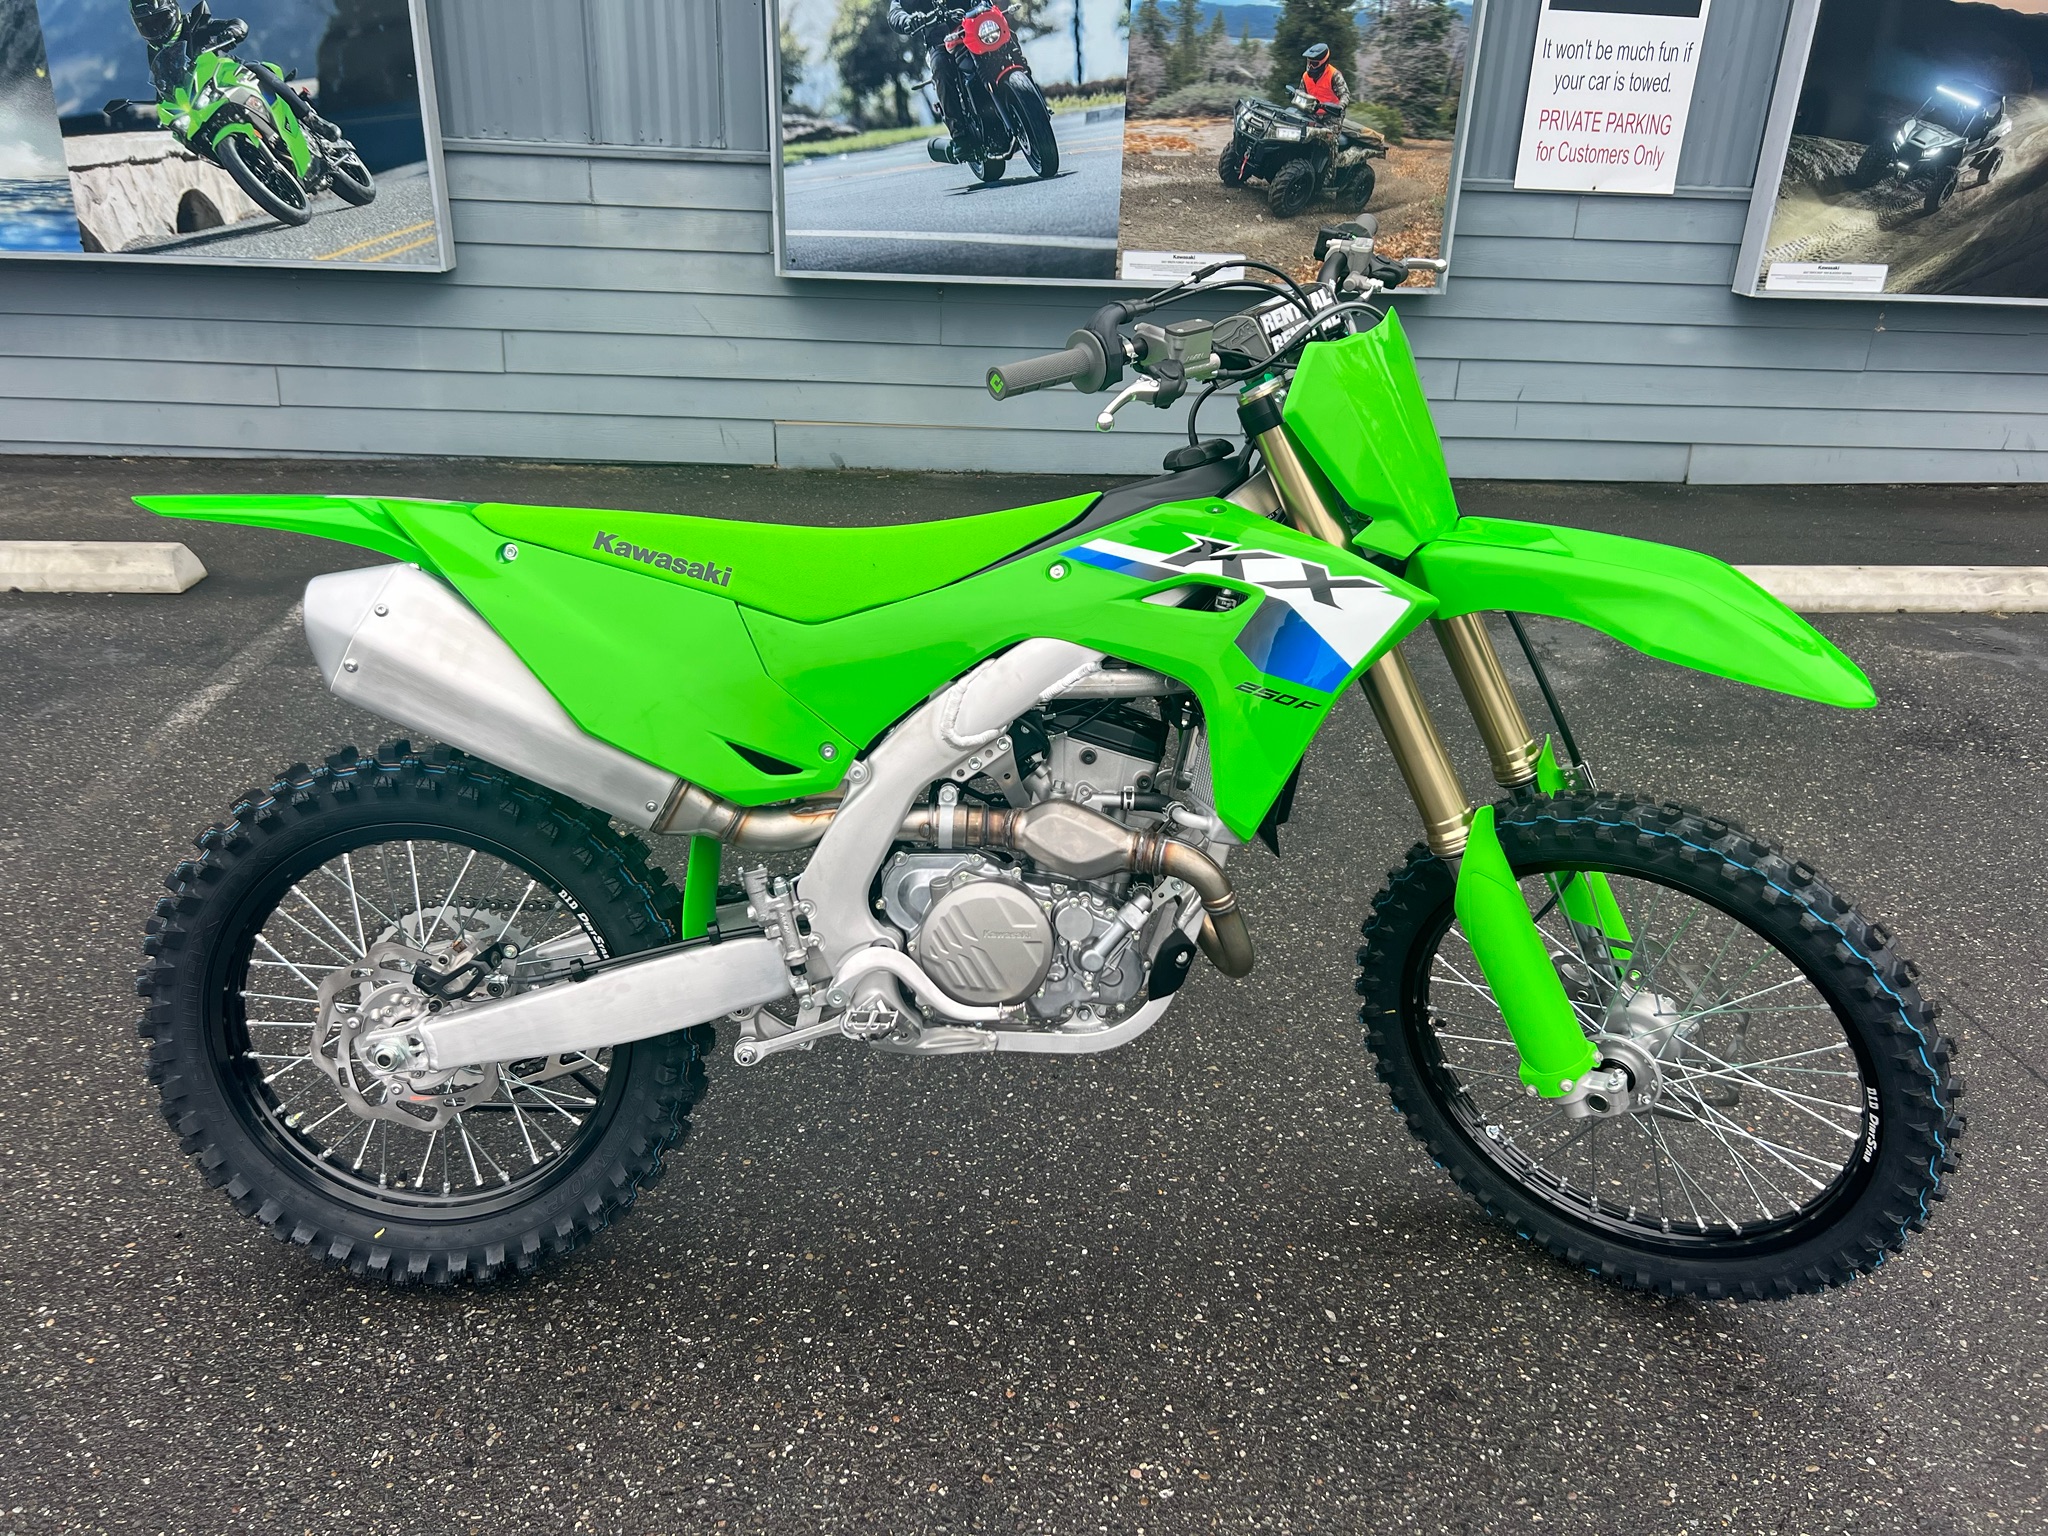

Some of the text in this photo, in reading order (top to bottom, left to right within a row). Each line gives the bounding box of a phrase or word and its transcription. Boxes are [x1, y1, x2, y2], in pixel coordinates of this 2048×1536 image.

[1542, 38, 1695, 63] It won't be much fun if
[1553, 71, 1671, 95] your car is towed.
[1538, 109, 1672, 136] PRIVATE PARKING
[1535, 141, 1665, 172] for Customers Only
[592, 529, 734, 588] Kawasaki
[1234, 681, 1322, 710] 250F
